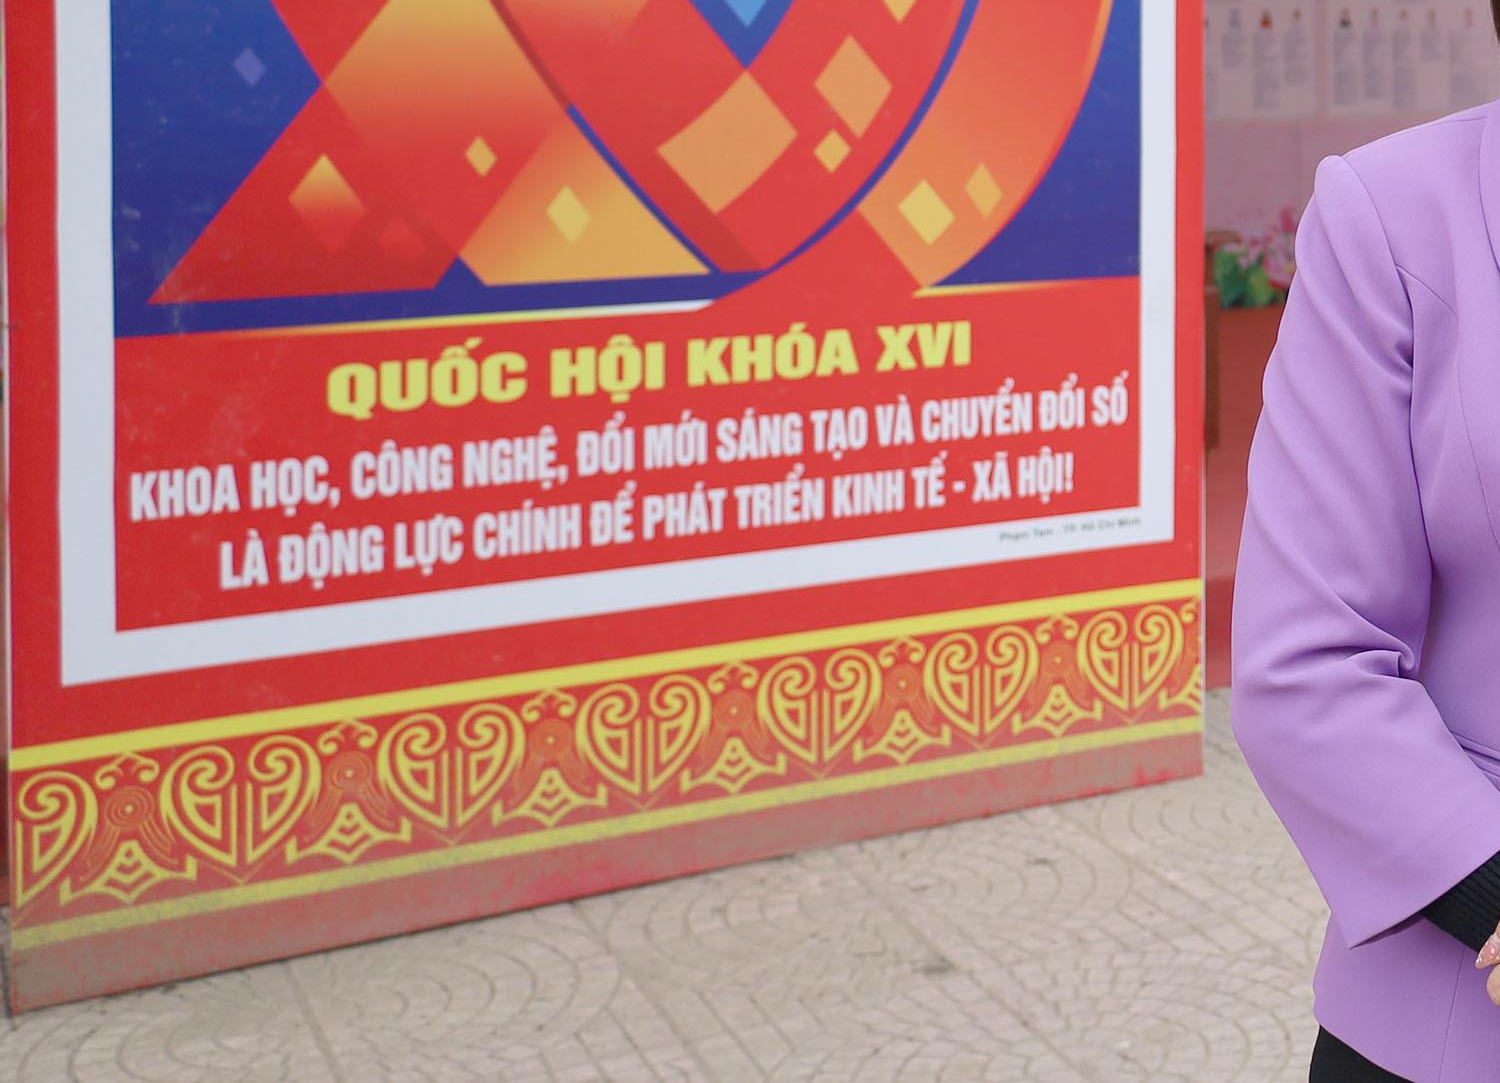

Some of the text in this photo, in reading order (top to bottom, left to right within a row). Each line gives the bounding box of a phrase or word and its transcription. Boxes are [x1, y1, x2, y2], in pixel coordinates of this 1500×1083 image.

[327, 320, 972, 420] QUỐC HỘI KHÓA XVI
[129, 369, 1130, 522] KHOA HỌC, CÔNG NGHỆ, ĐỔI MỚI SÁNG TẠO VÀ CHUYỂN ĐỔI SỐ
[219, 529, 270, 591] LÀ
[277, 522, 386, 590] ĐỘNG
[394, 513, 465, 577] LỰC
[473, 500, 583, 560] CHÍNH
[589, 481, 638, 548] ĐỂ
[642, 478, 725, 541] PHÁT
[734, 463, 825, 531] TRIỂN
[831, 468, 906, 518] KINH
[911, 450, 949, 509] TẾ
[972, 452, 1012, 503] XÃ
[1017, 445, 1076, 505] HỘI!
